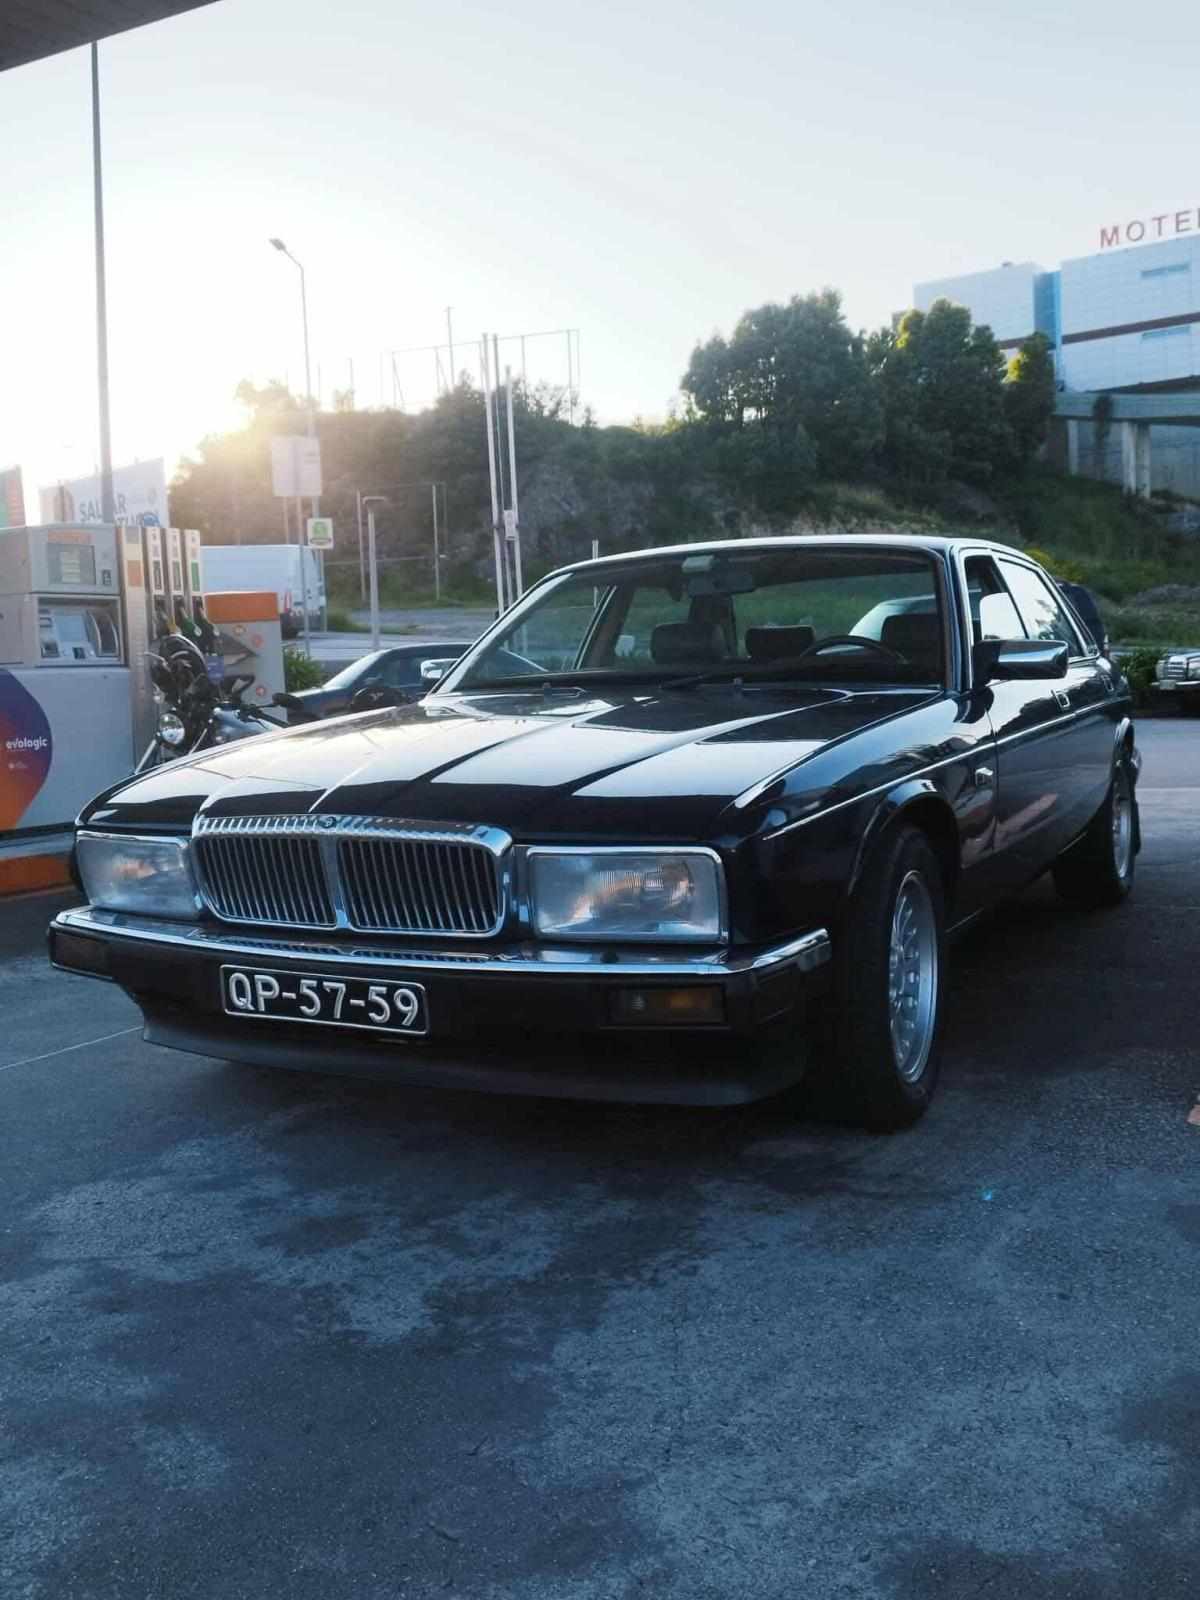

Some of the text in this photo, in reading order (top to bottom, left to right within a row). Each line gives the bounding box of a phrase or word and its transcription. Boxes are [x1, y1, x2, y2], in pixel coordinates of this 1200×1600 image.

[1100, 207, 1200, 248] MOTE
[6, 736, 48, 750] evologic
[228, 972, 418, 1026] QP-57-59
